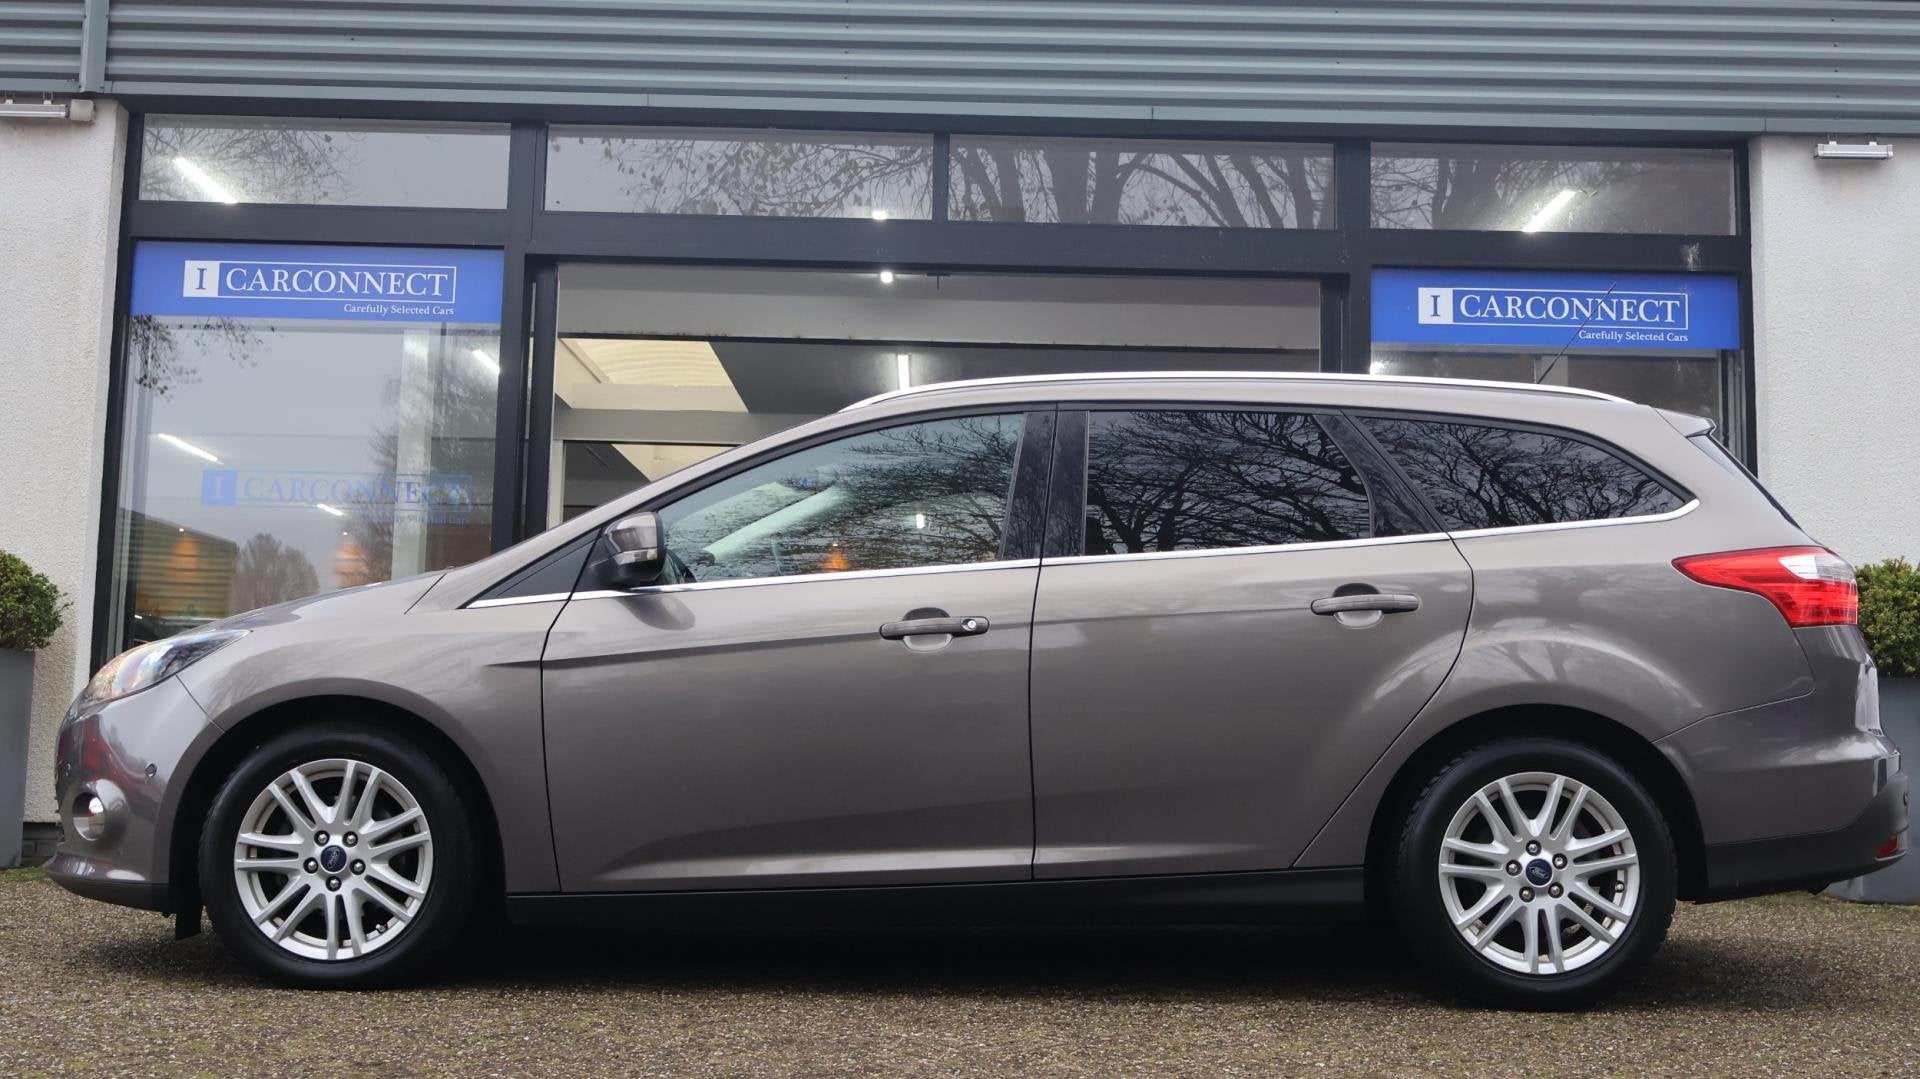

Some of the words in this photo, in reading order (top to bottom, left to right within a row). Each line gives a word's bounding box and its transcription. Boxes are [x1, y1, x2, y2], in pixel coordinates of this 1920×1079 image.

[225, 268, 448, 296] CARCONNECT
[343, 303, 389, 316] Carefully
[391, 304, 430, 315] Selected
[432, 305, 454, 315] Cars
[1459, 294, 1681, 323] CARCONNECT
[1578, 330, 1624, 343] Carefully
[1625, 331, 1665, 342] Selected
[1667, 332, 1689, 342] Cars
